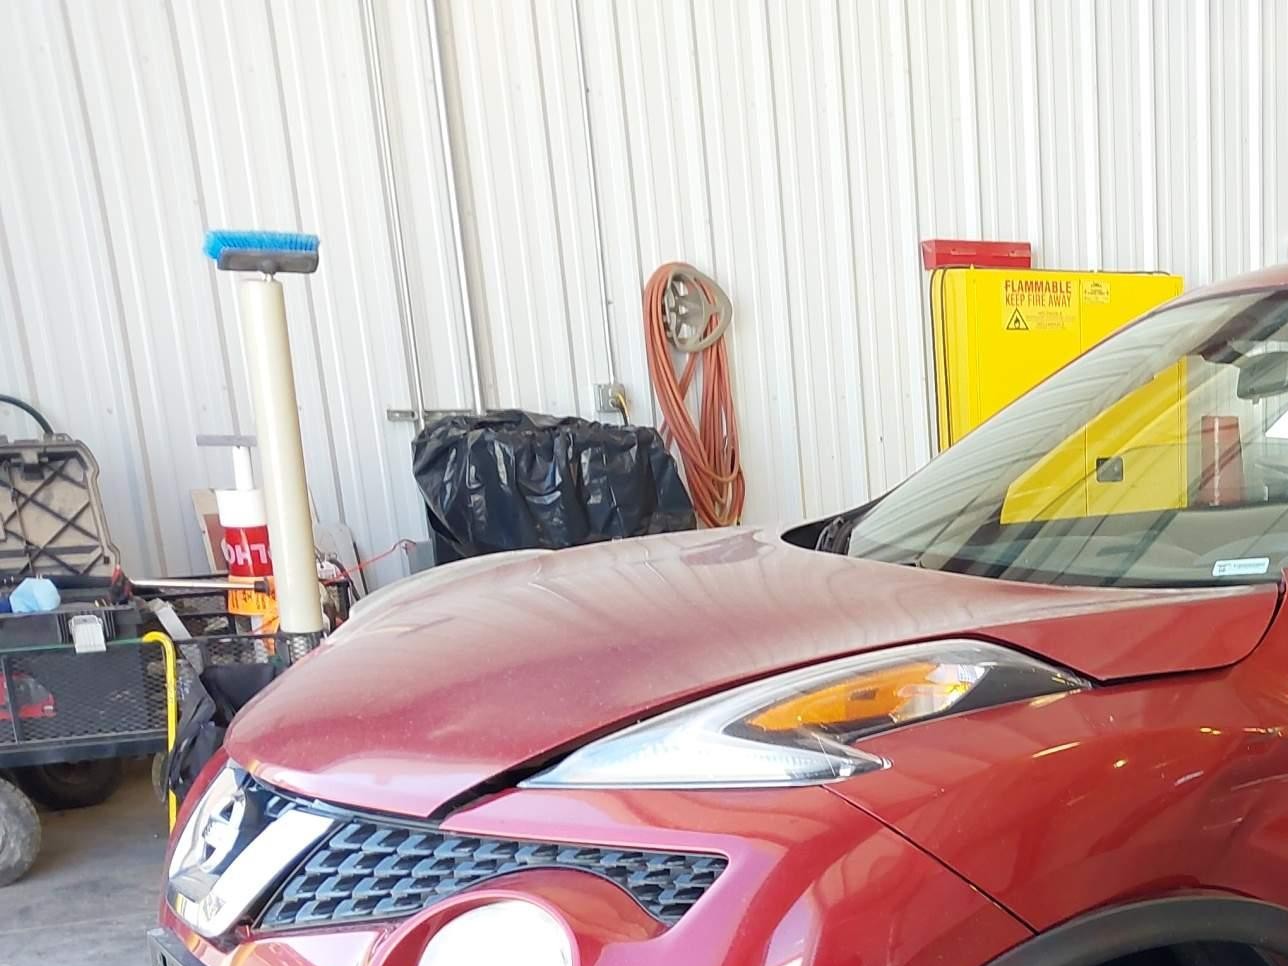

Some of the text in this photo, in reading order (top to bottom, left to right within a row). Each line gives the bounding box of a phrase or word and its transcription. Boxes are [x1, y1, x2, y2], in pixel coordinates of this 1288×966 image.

[1004, 280, 1072, 293] FLAMMABLE
[1005, 293, 1072, 308] KEEP FIRE AWAY
